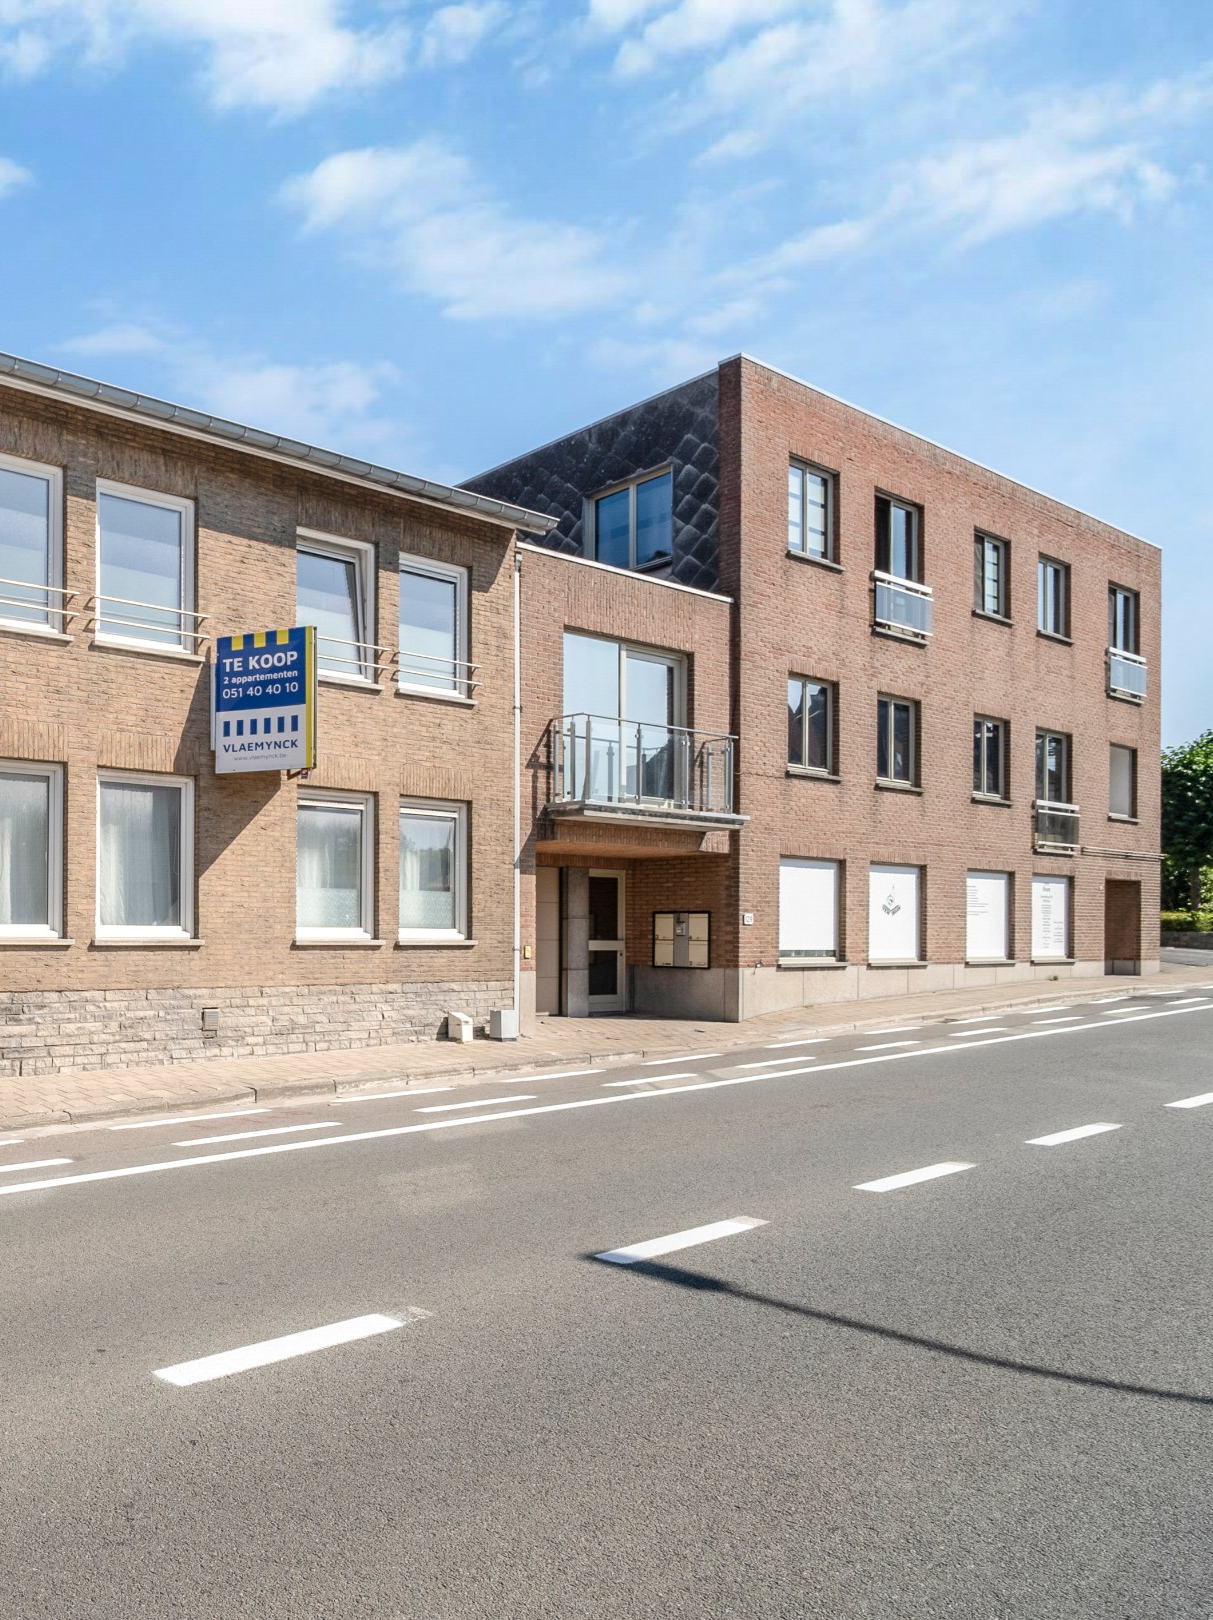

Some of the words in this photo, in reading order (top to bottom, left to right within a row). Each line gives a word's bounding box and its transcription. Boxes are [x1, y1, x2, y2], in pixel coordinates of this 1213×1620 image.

[223, 657, 243, 672] TE
[249, 651, 298, 670] KOOP
[223, 676, 229, 684] 2
[231, 670, 298, 685] appartementen
[222, 688, 243, 699] 051
[247, 686, 263, 697] 40
[265, 684, 281, 695] 40
[285, 682, 299, 693] 10
[223, 739, 298, 753] VLAEMYNCK
[234, 753, 287, 761] www.vlaemynck.be
